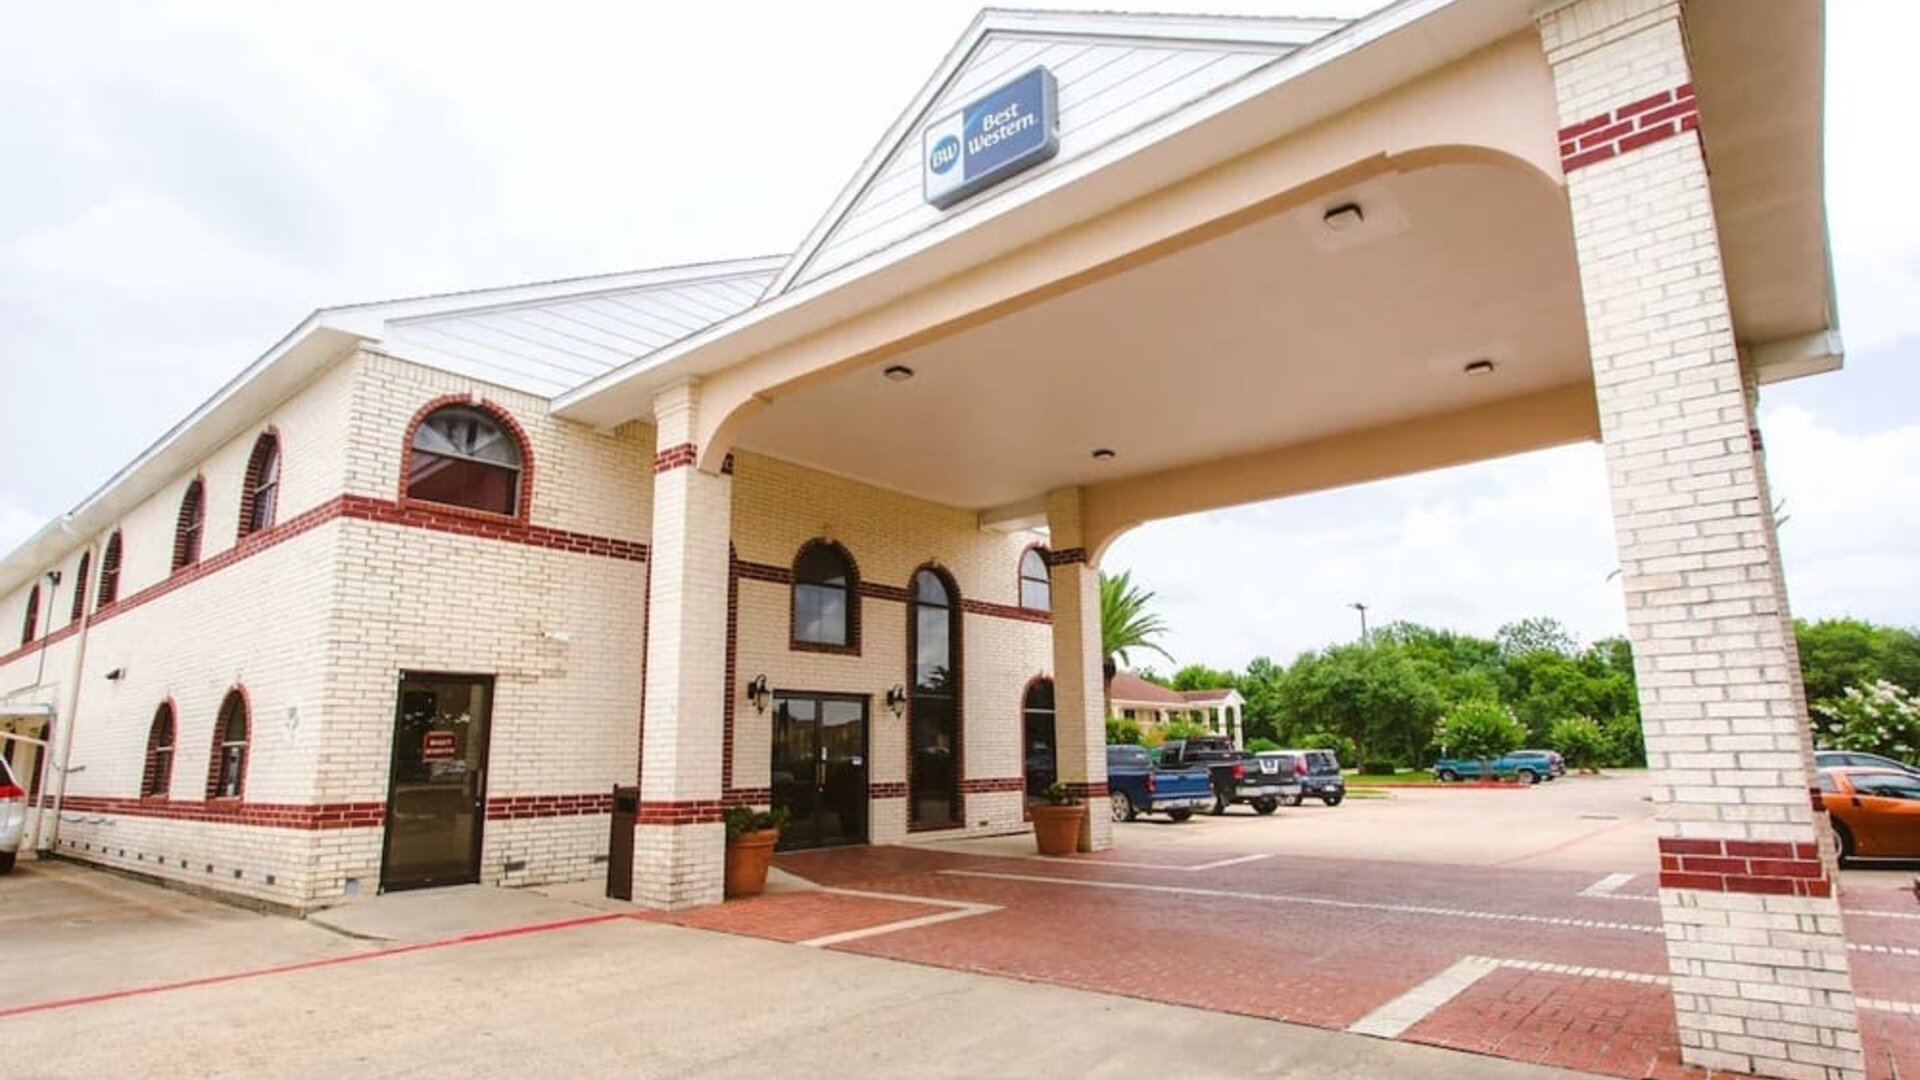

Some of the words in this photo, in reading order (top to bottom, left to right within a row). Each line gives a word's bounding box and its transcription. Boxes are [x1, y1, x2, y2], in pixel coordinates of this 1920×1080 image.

[983, 103, 1018, 132] Best
[968, 113, 1034, 155] Western
[932, 142, 958, 169] BW
